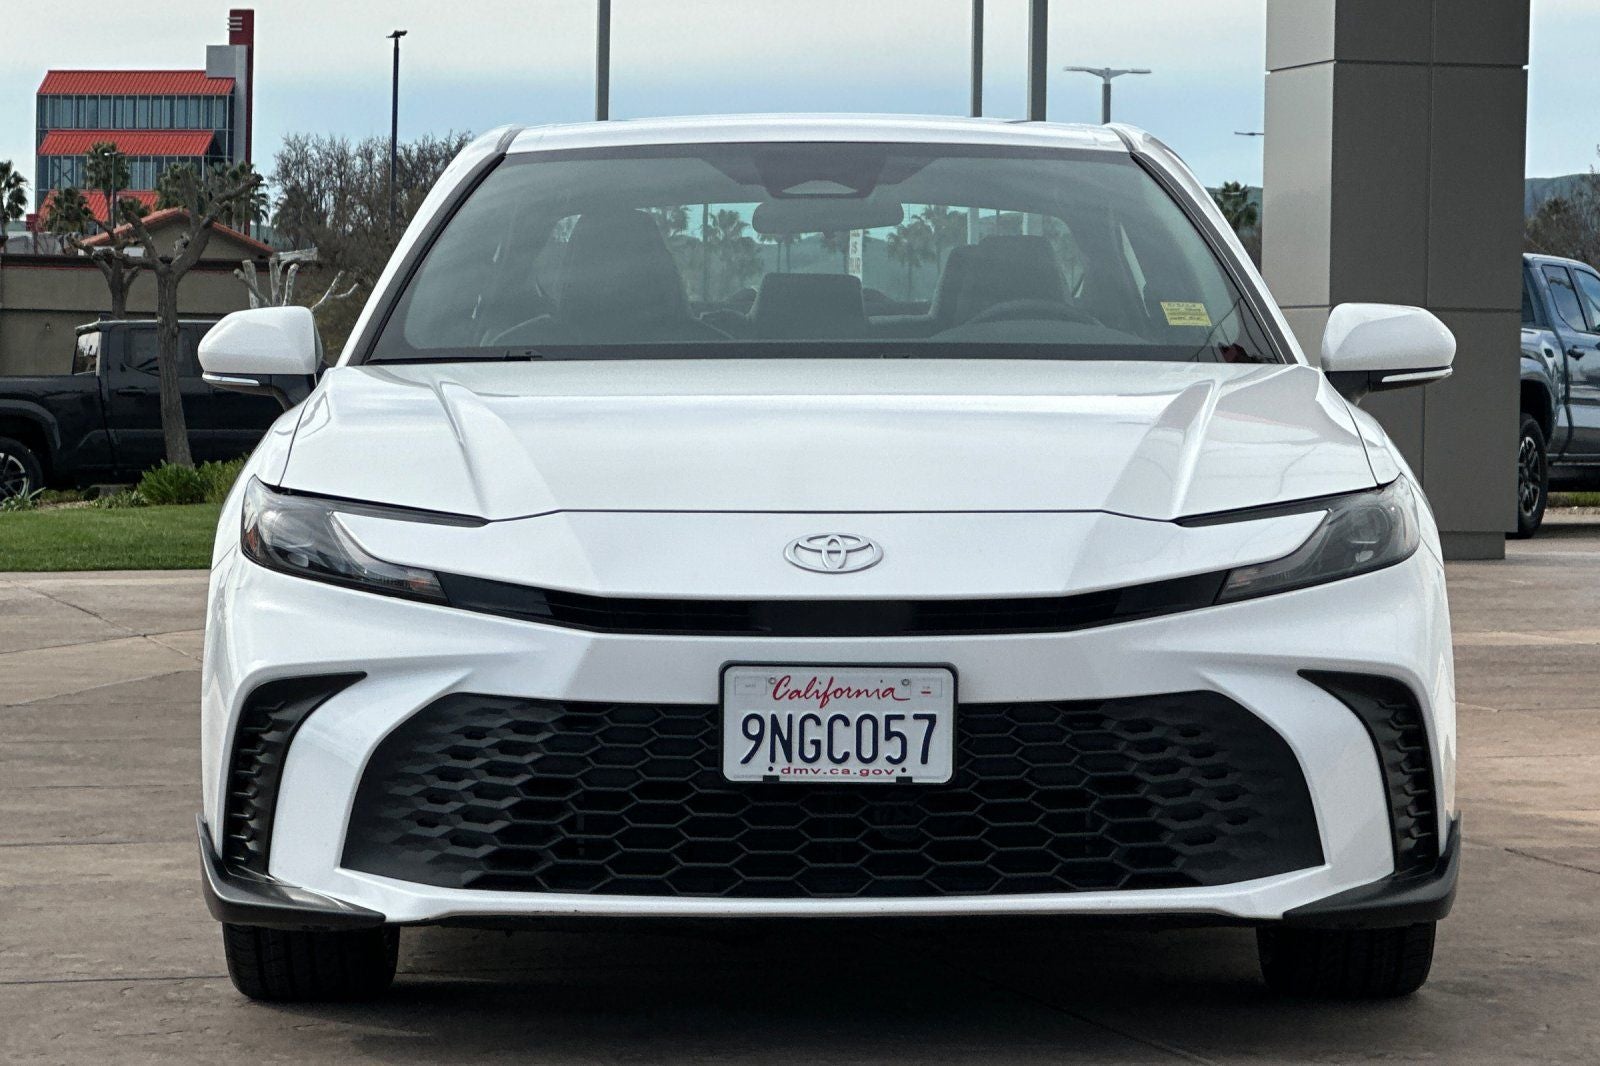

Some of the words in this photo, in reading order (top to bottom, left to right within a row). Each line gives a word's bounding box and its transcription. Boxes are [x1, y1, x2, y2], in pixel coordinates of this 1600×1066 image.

[772, 675, 910, 708] California
[740, 713, 936, 765] 9NGC057
[781, 766, 895, 777] dmv.ca.gov
